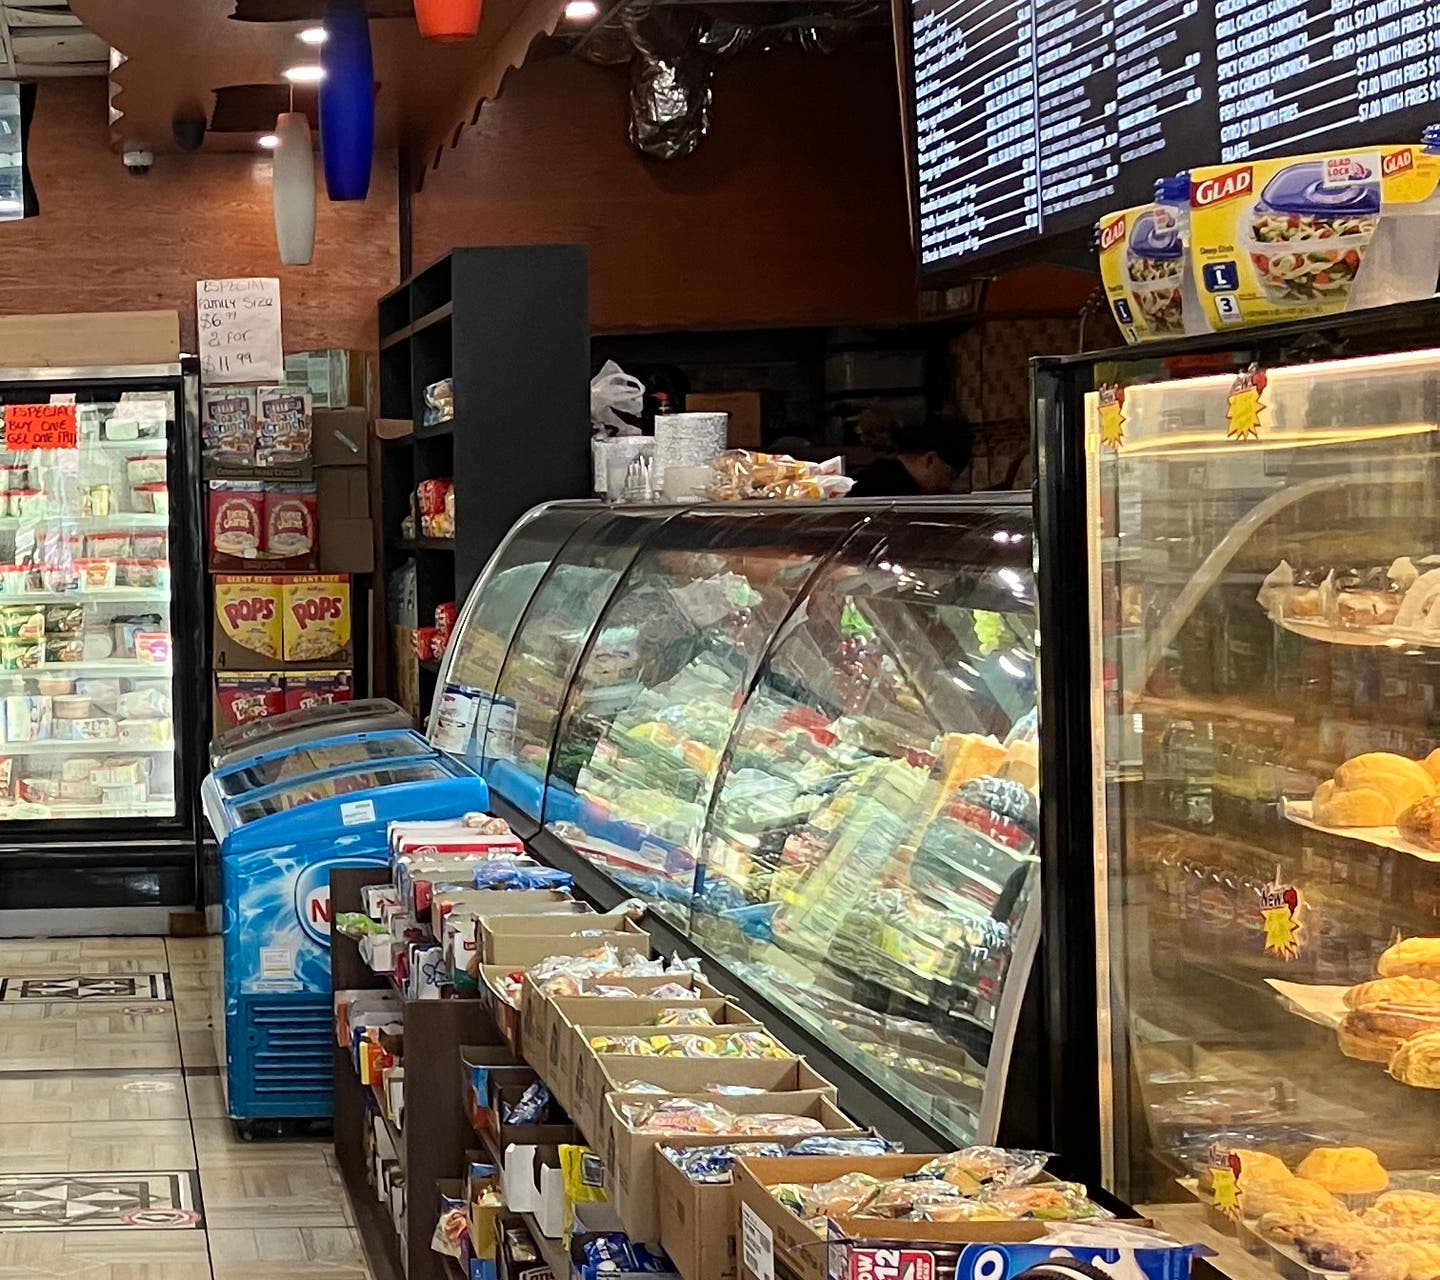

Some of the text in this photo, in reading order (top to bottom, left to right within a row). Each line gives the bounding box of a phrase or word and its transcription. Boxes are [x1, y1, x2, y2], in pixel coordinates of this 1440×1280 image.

[1384, 150, 1412, 174] GLAD
[1196, 170, 1251, 205] GLAD
[1101, 219, 1124, 247] GLAD
[1221, 297, 1233, 312] 3
[223, 597, 275, 630] POPS
[291, 597, 342, 630] POPS
[874, 1248, 900, 1280] 12
